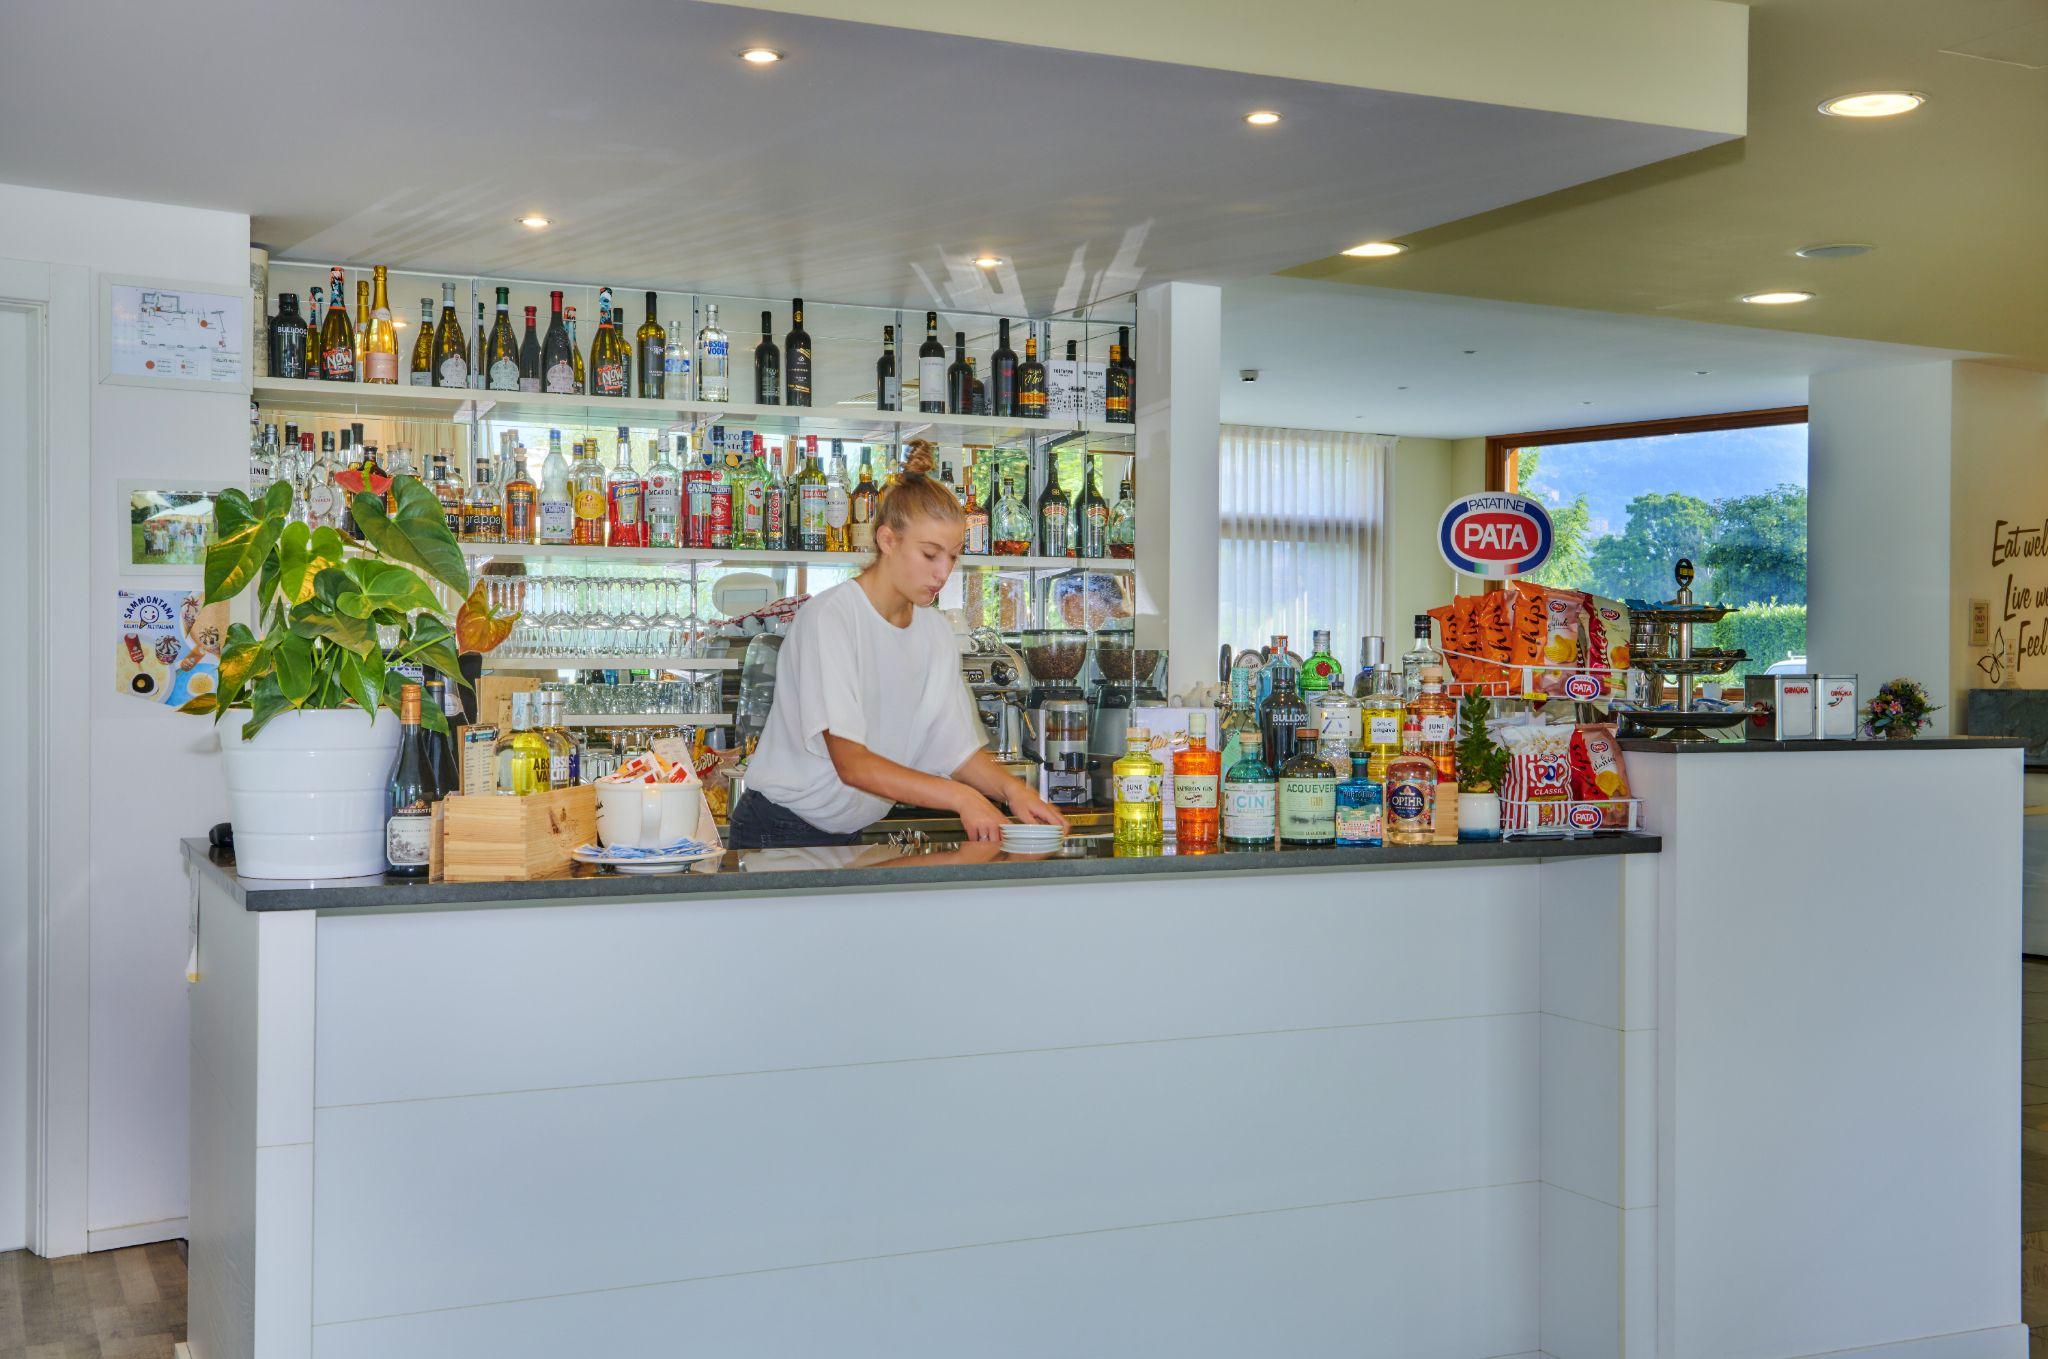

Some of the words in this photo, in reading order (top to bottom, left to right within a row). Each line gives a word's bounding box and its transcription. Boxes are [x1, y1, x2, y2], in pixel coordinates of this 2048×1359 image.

[1468, 497, 1526, 512] PATATINE
[466, 514, 501, 526] grappa
[1464, 523, 1529, 550] PATA
[1992, 519, 2040, 568] Eat
[2004, 573, 2032, 622] Live
[123, 595, 175, 620] SAMMONTANA
[1521, 595, 1547, 658] chips
[2017, 617, 2048, 673] Feel
[1573, 683, 1592, 693] PATA
[1784, 686, 1809, 694] GIMOKA
[1533, 763, 1566, 784] POP
[1534, 788, 1564, 796] CLASSIC
[1392, 796, 1424, 807] OPIHR
[1575, 813, 1595, 822] PATA
